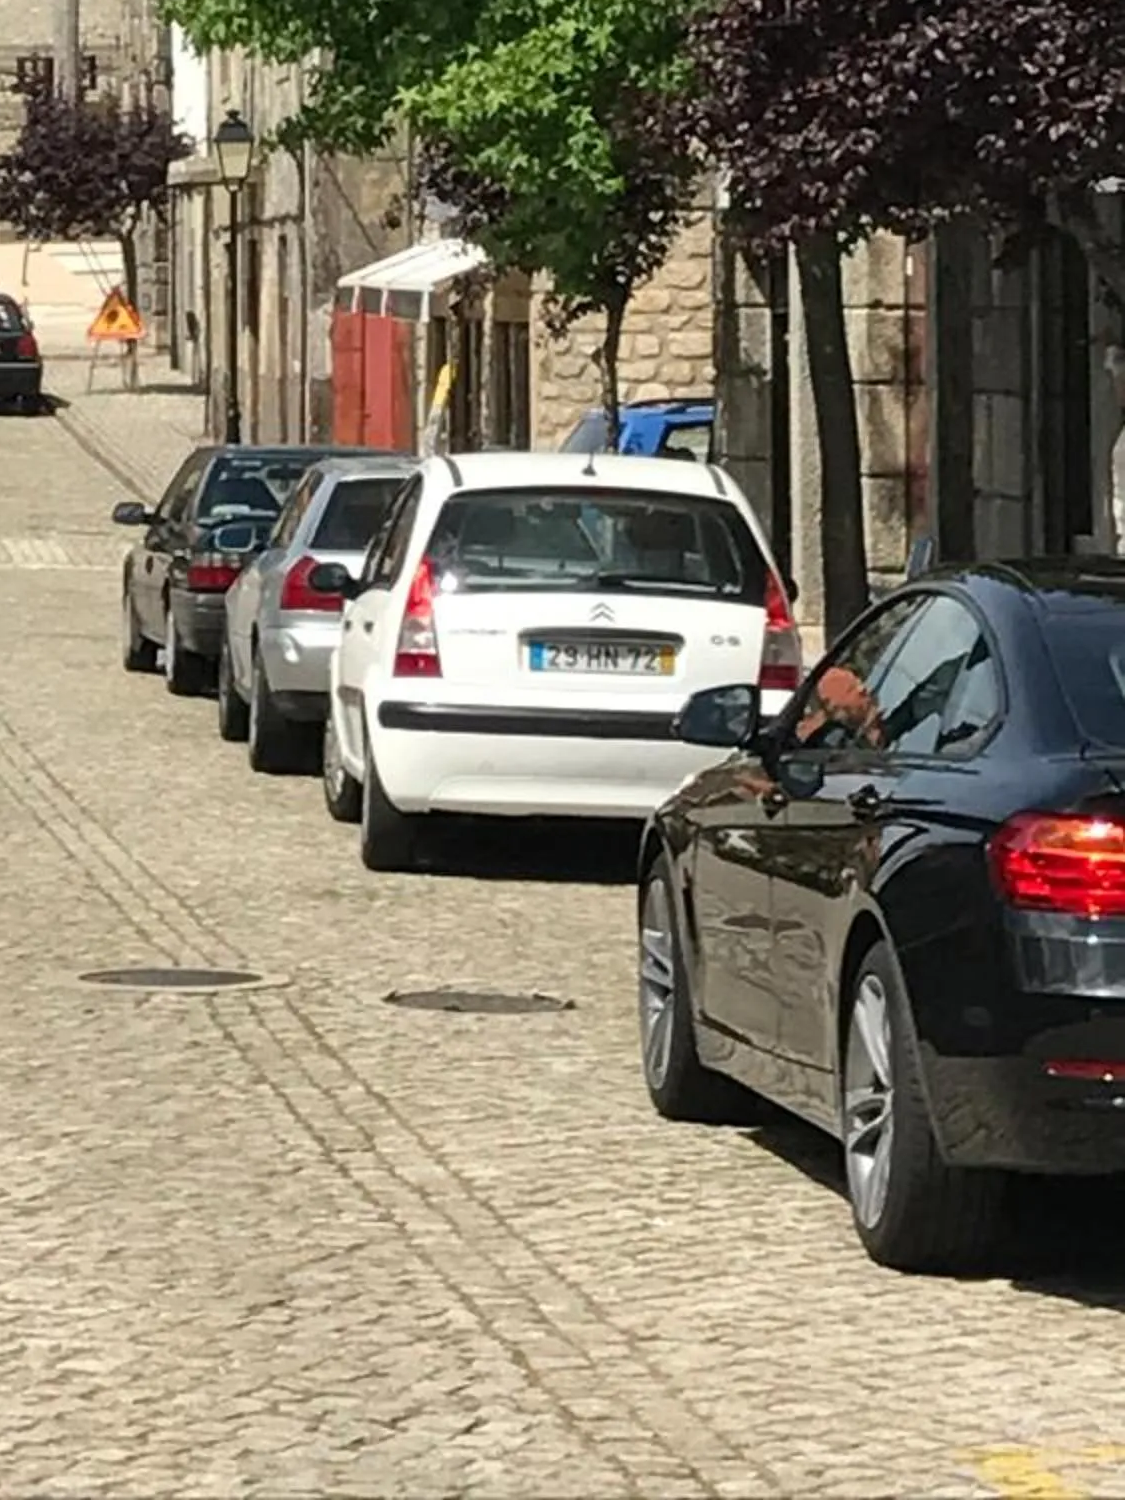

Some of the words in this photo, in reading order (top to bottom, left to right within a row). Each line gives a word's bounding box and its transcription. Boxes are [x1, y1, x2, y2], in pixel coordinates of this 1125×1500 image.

[547, 644, 578, 667] 29
[586, 644, 619, 669] HN
[627, 645, 657, 671] 72
